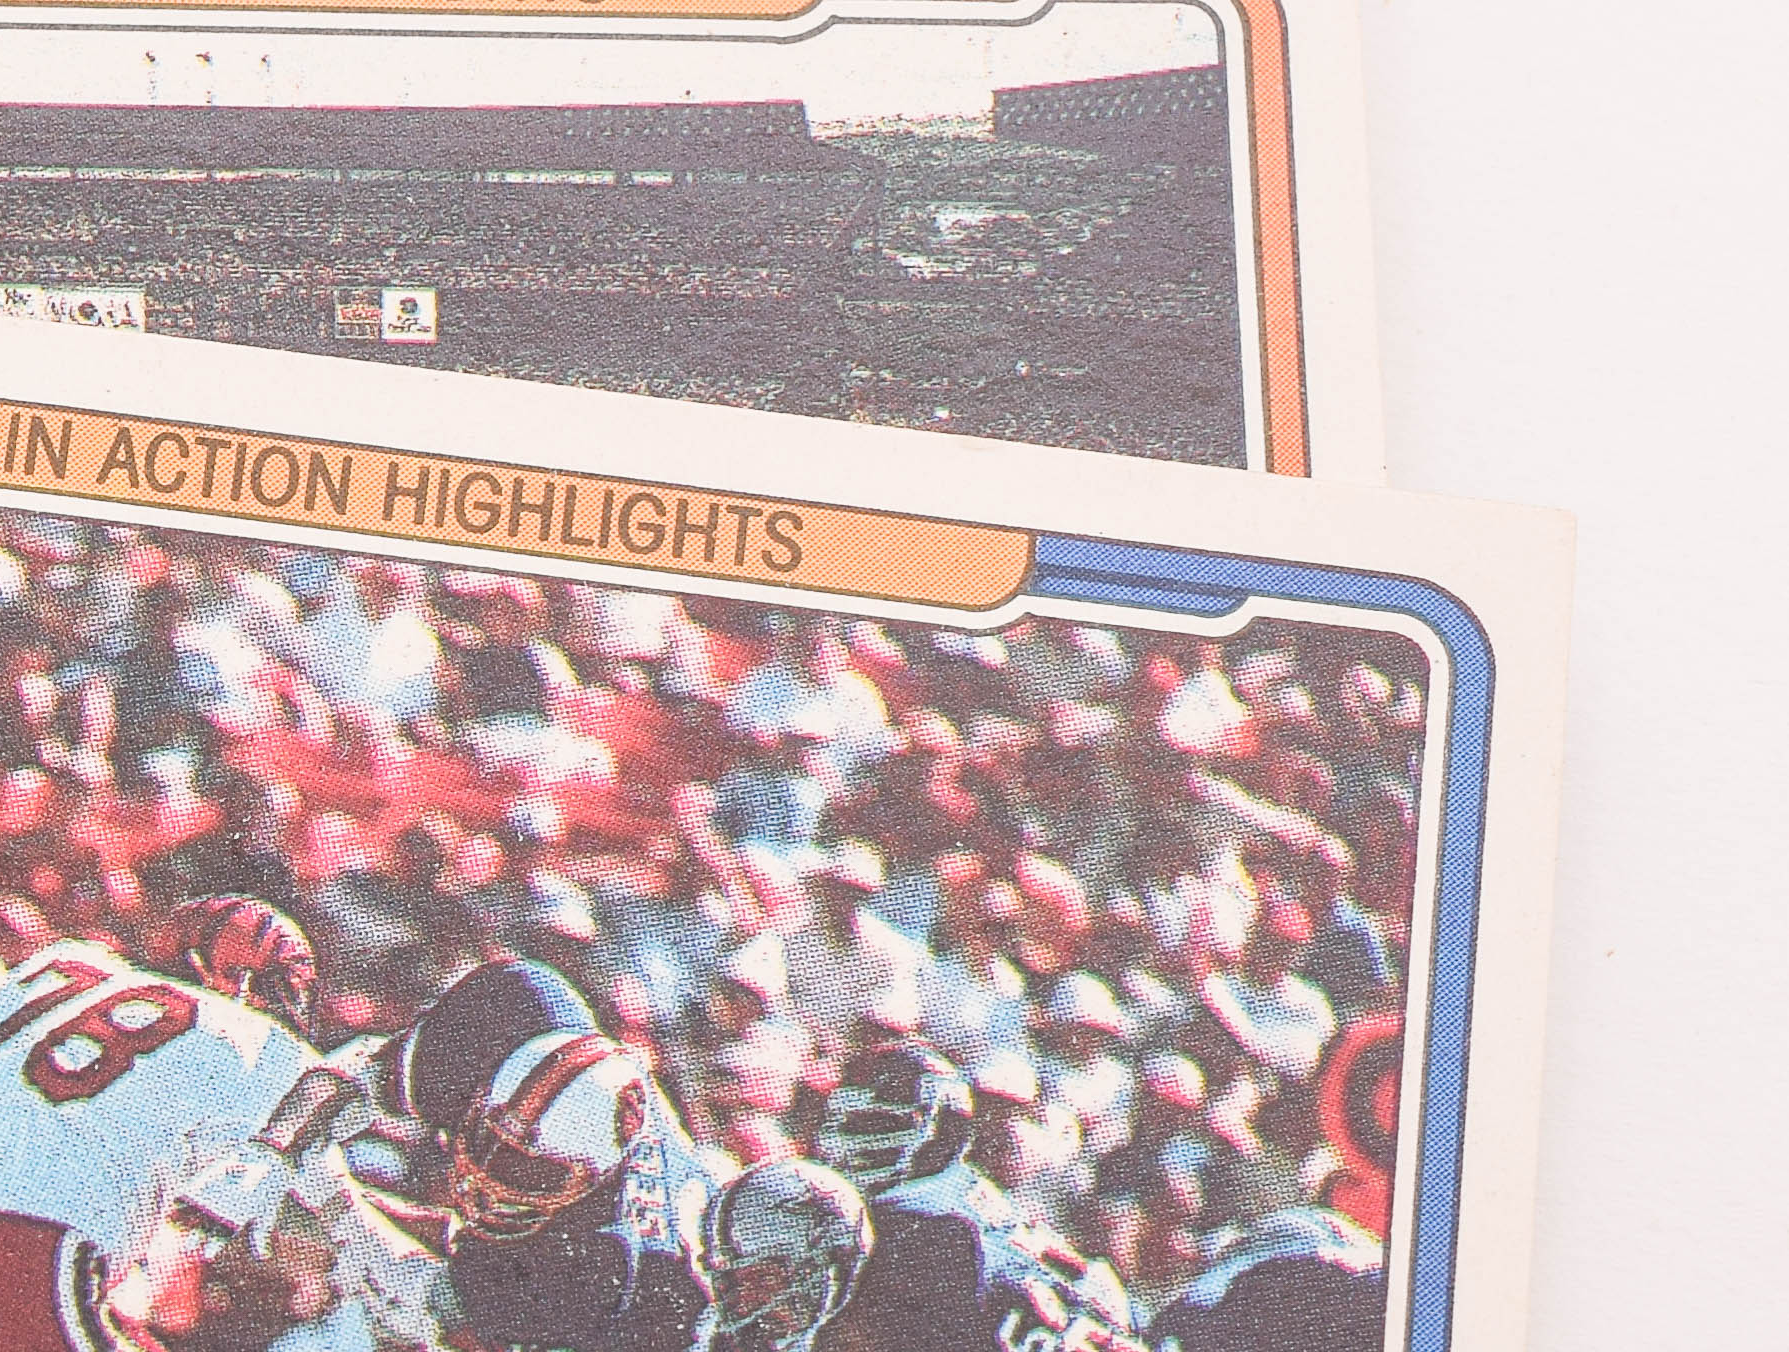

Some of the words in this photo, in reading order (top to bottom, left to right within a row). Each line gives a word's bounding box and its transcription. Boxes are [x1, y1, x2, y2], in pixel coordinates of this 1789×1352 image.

[4, 412, 73, 480] IN
[96, 426, 353, 516] ACTION
[382, 460, 805, 573] HIGHLIGHTS
